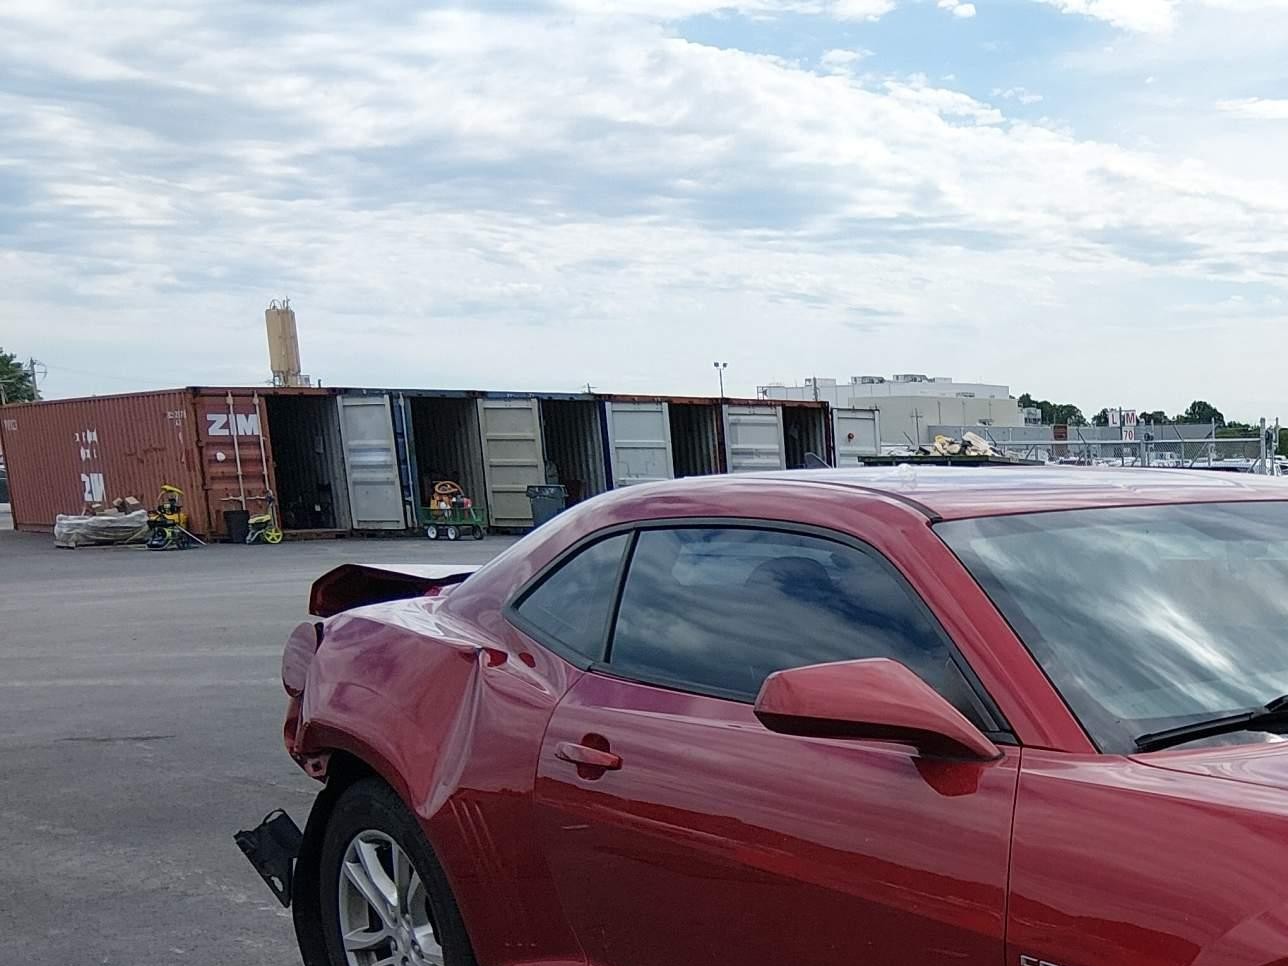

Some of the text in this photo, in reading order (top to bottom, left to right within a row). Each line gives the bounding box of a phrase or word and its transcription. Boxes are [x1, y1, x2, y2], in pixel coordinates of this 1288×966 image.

[206, 413, 260, 436] ZIM
[1111, 412, 1135, 425] L M
[1123, 430, 1134, 441] 70
